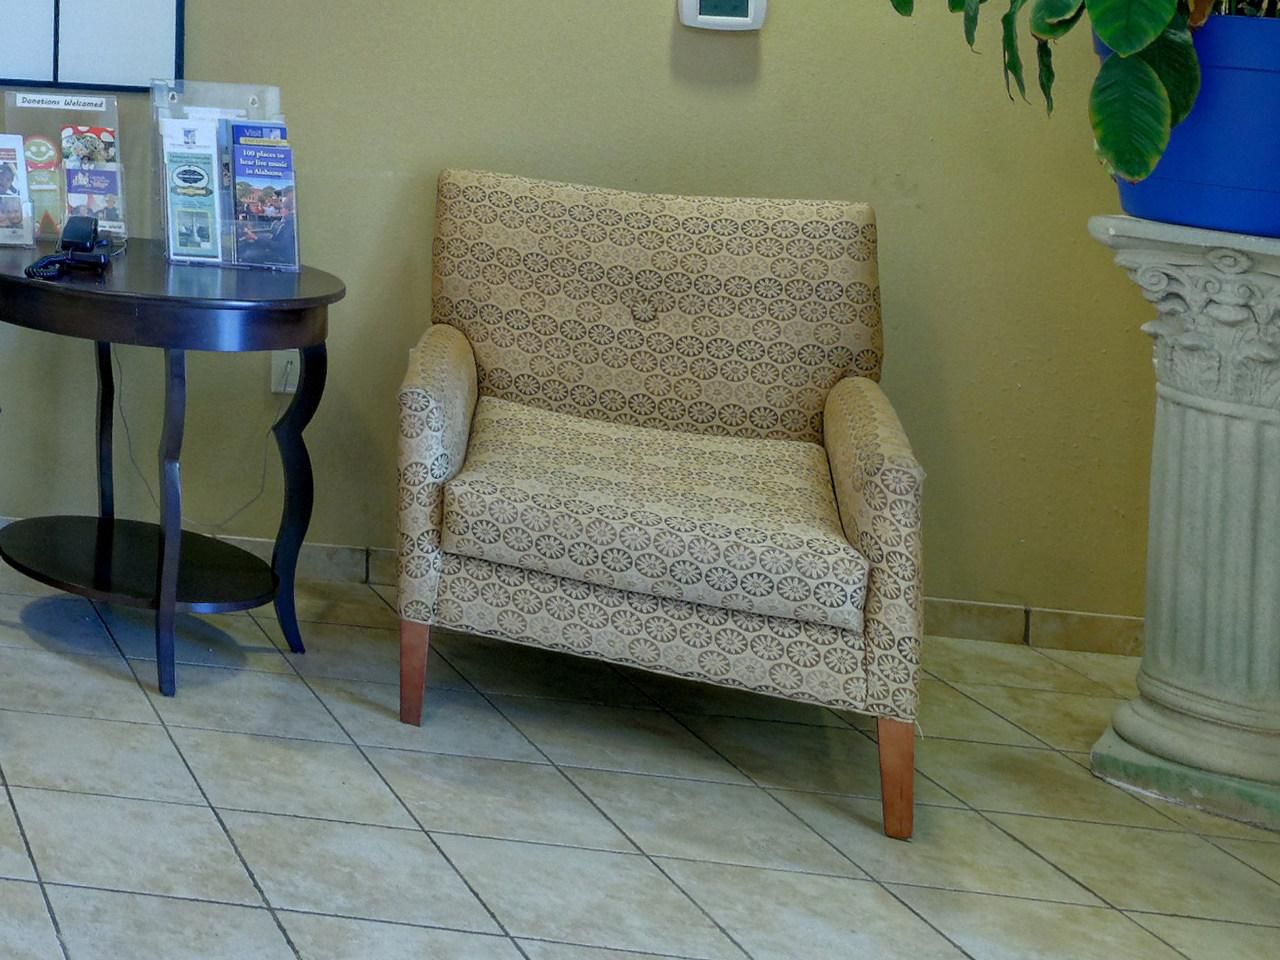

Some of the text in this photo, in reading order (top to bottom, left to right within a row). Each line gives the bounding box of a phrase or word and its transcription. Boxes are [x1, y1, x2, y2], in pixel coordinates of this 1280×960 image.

[63, 100, 104, 108] Welcomed
[243, 127, 262, 137] Visit
[256, 150, 276, 158] places
[239, 158, 254, 166] hear
[254, 168, 283, 176] Alabama
